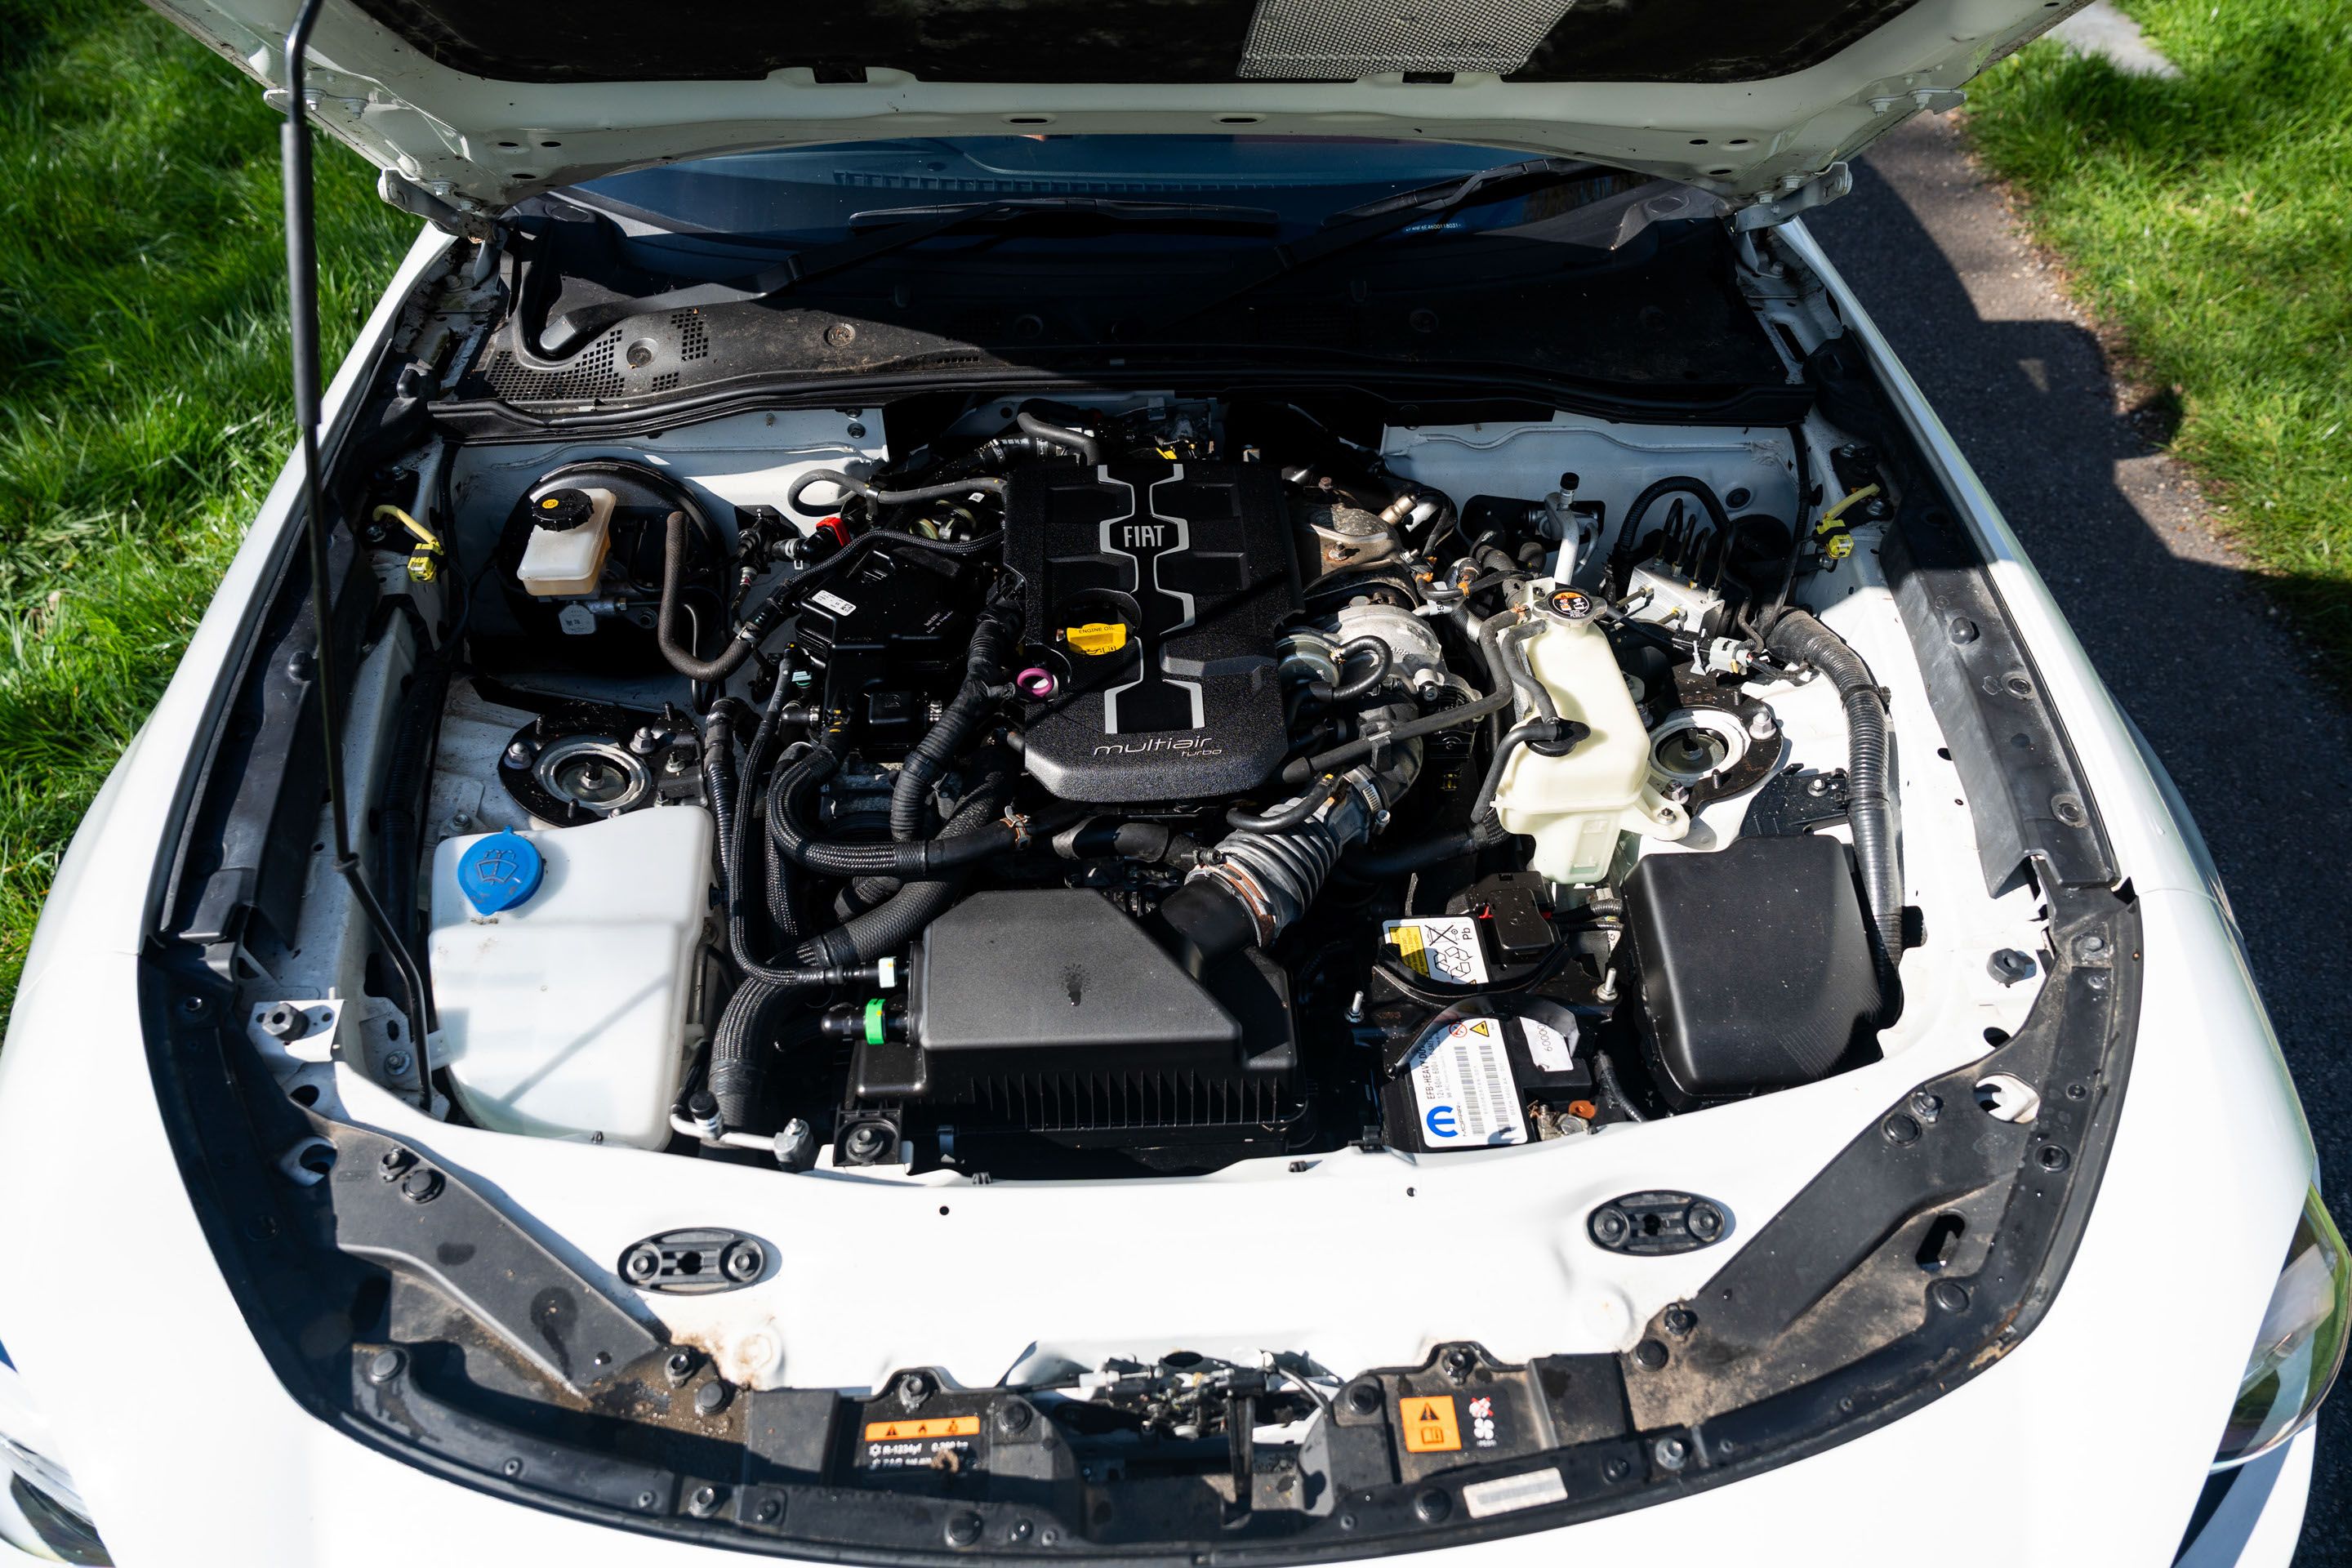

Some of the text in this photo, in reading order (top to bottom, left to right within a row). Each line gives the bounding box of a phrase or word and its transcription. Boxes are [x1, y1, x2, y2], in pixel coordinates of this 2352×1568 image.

[1124, 525, 1165, 547] FIAT
[1094, 736, 1212, 756] multiair
[1181, 747, 1223, 757] turbo
[1462, 927, 1473, 941] Pb
[1419, 1058, 1436, 1099] EFB-HEAVY
[1456, 1105, 1467, 1137] MOPAR
[882, 1442, 922, 1455] R-1234yf
